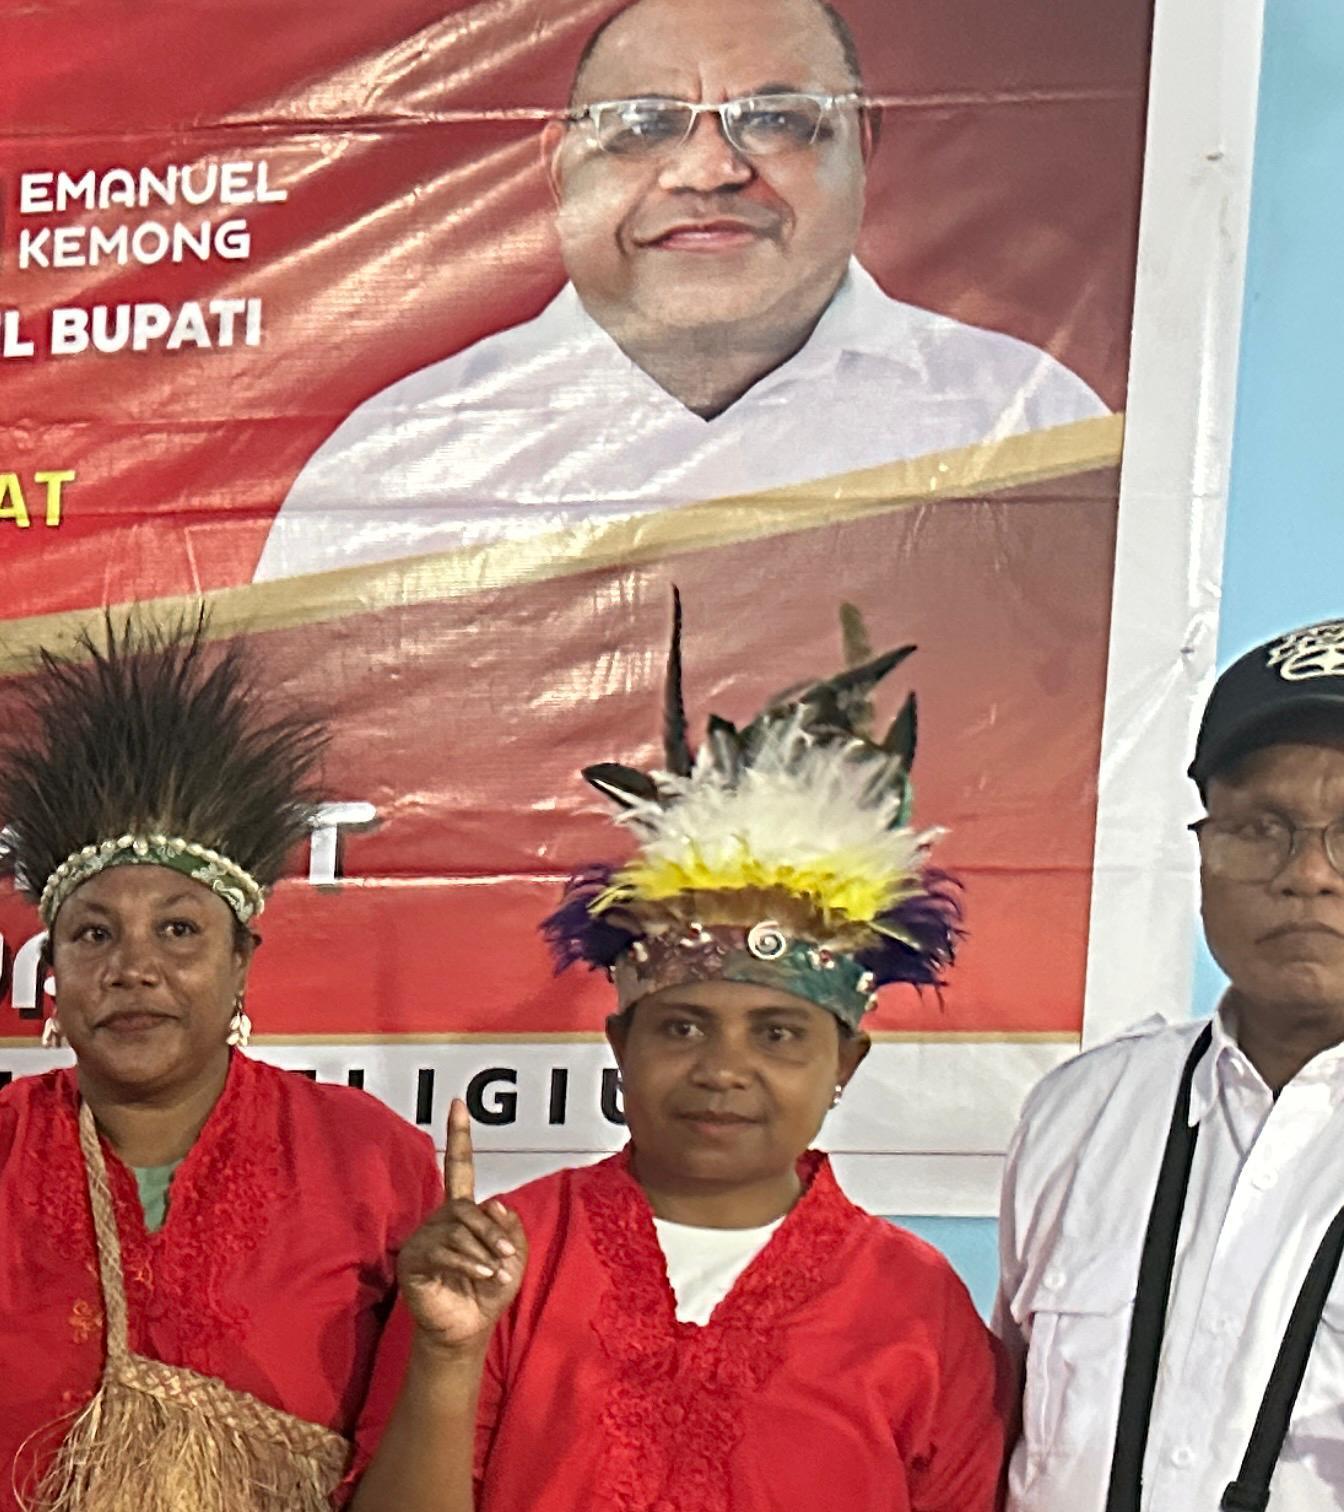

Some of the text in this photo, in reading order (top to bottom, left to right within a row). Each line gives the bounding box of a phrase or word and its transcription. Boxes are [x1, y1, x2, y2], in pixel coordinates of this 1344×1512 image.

[19, 160, 288, 213] EMANUEL
[19, 218, 251, 269] KEMONG
[50, 298, 262, 354] BUPATI
